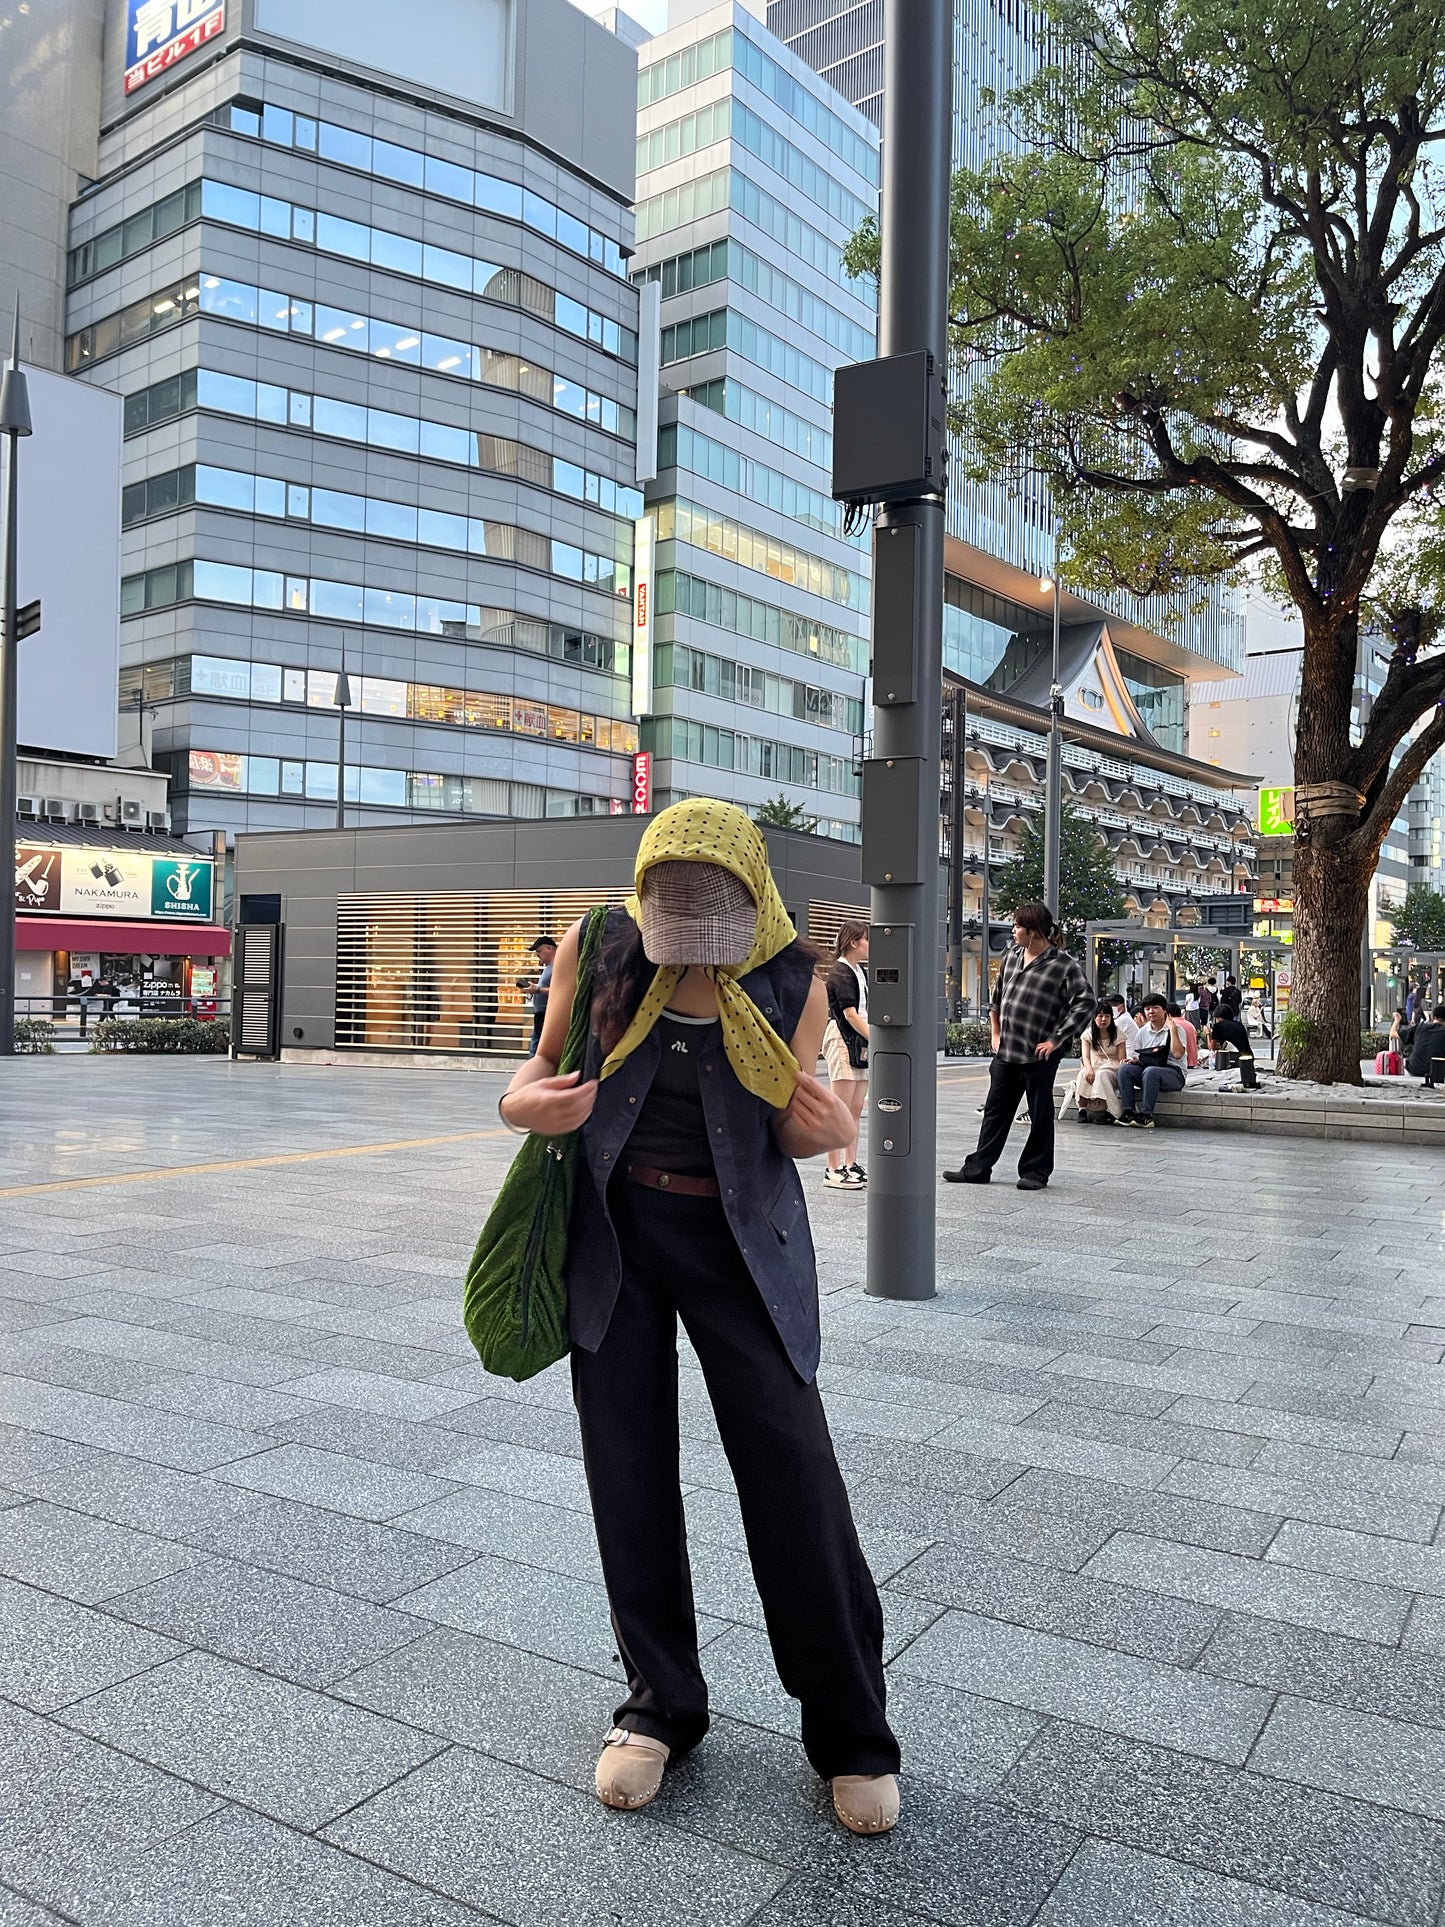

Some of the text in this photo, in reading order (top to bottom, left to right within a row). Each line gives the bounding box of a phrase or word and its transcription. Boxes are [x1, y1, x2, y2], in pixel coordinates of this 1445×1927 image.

[638, 584, 646, 626] VANTAN
[74, 888, 139, 900] NAKAMURA
[164, 901, 200, 911] SHISHA
